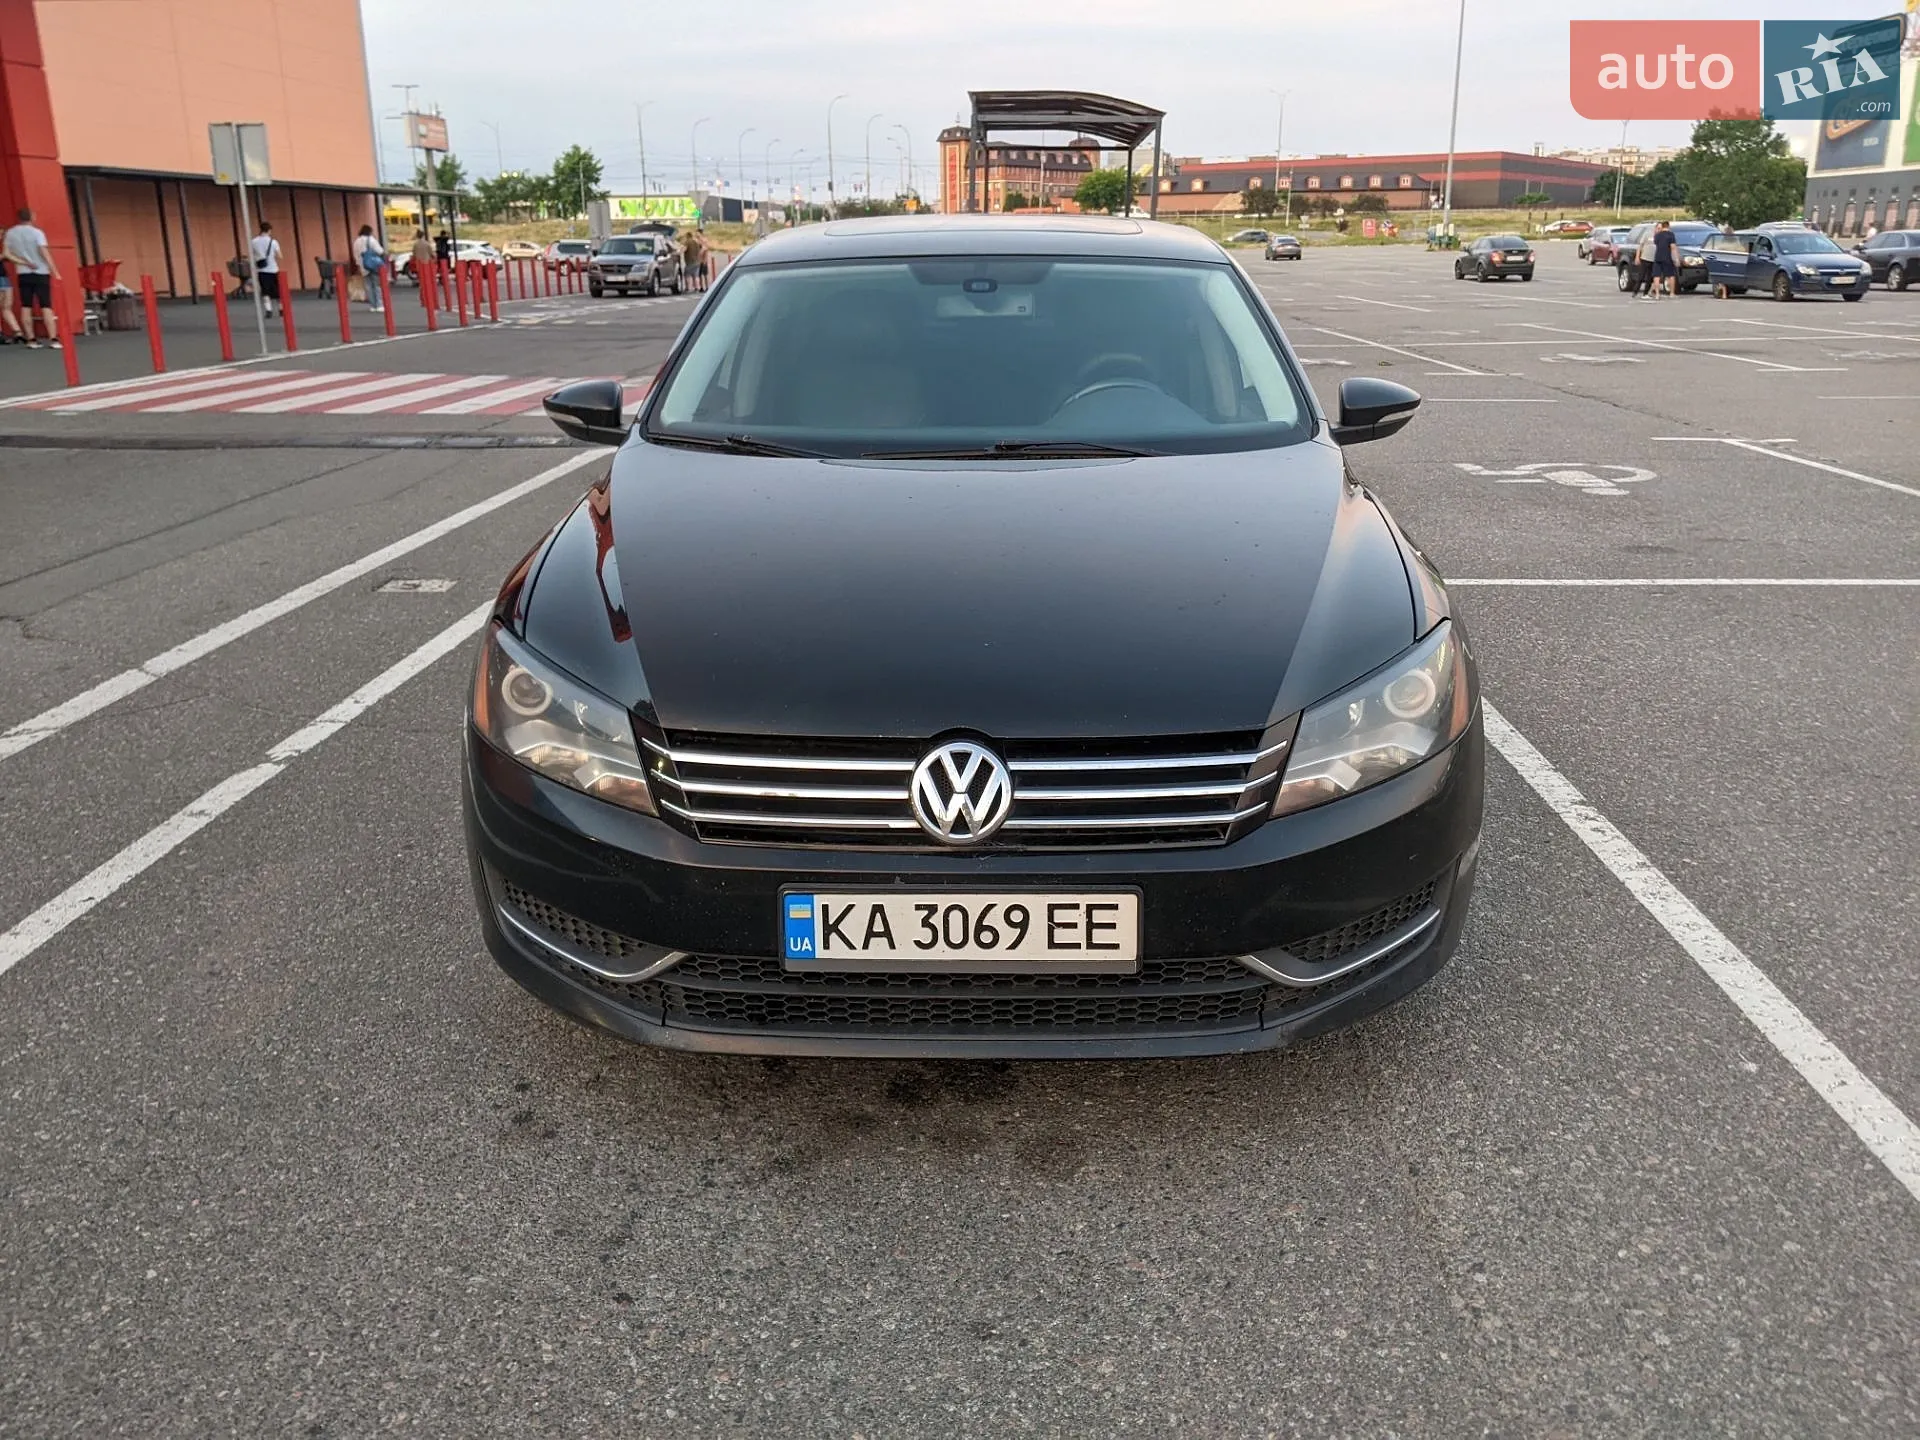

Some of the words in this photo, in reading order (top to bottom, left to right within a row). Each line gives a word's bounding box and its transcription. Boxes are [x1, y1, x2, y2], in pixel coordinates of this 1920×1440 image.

[619, 199, 697, 217] NOVUS
[821, 903, 897, 951] KA
[913, 903, 1030, 951] 3069
[1047, 903, 1121, 950] EE
[790, 937, 812, 951] UA
